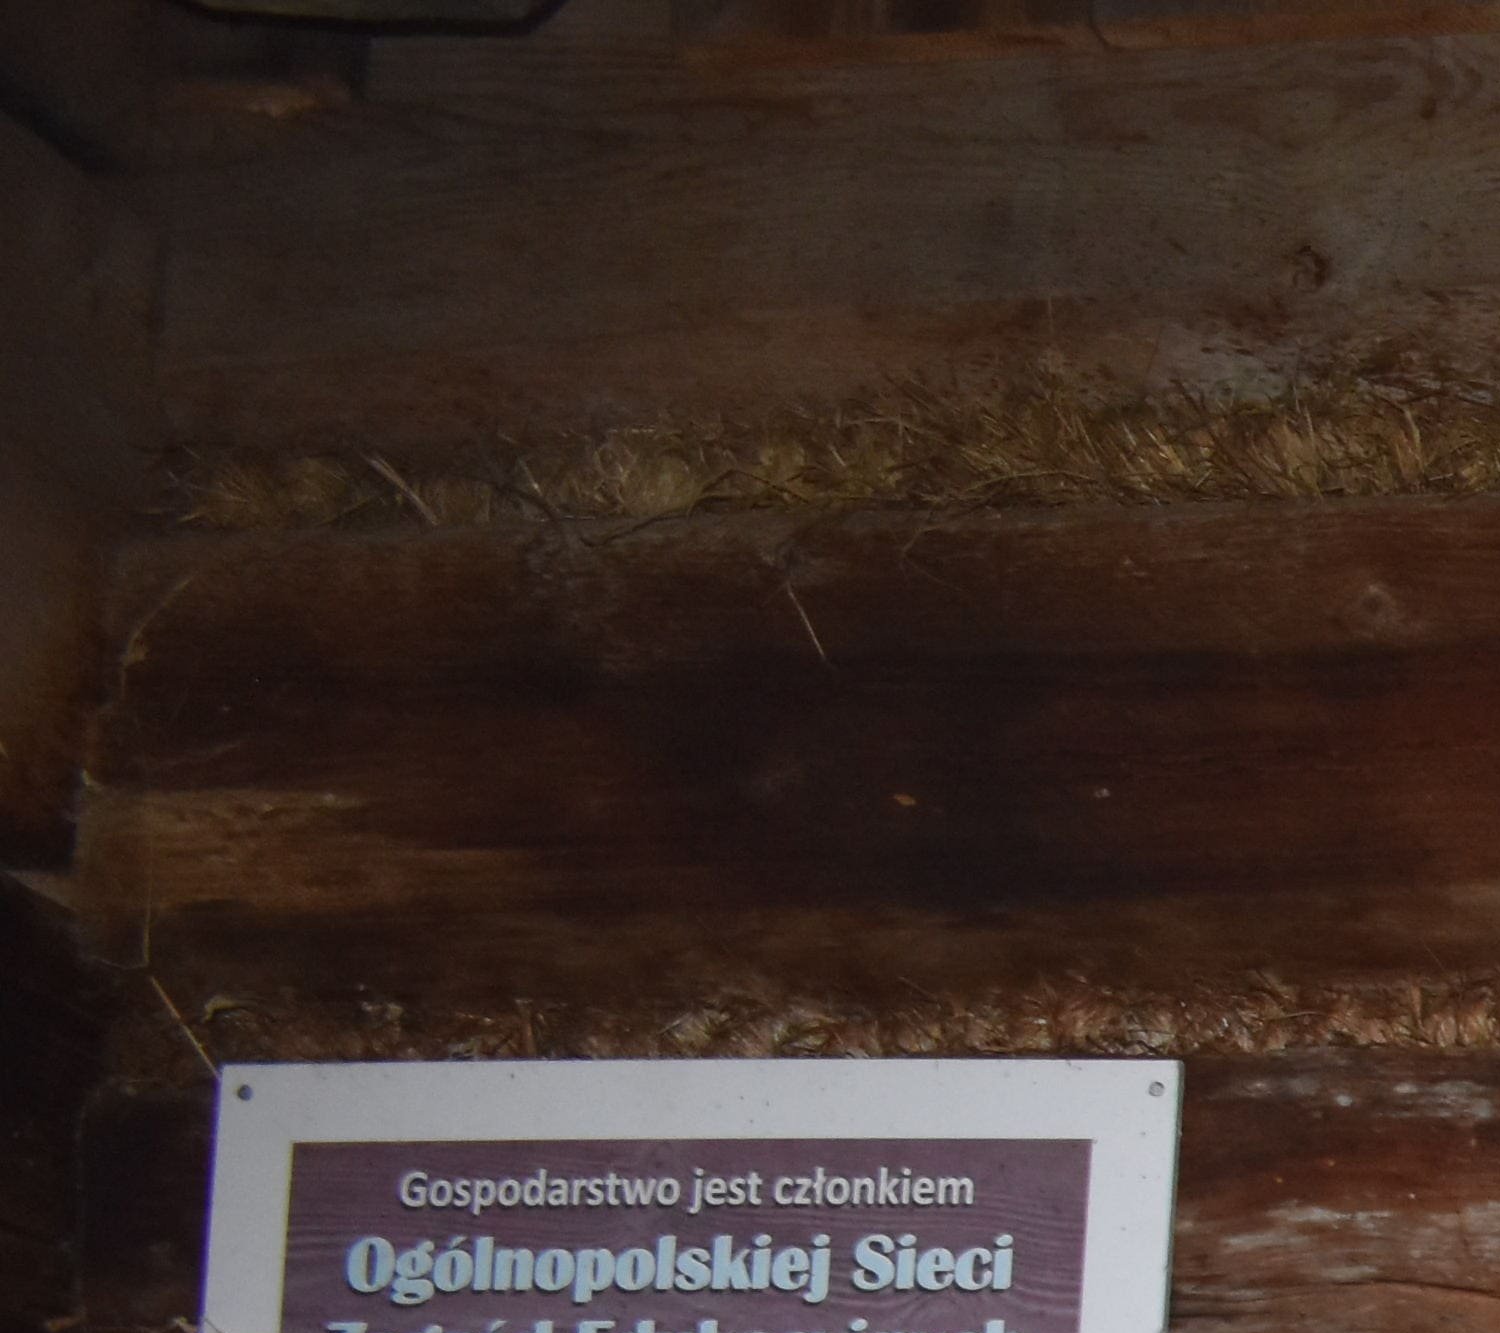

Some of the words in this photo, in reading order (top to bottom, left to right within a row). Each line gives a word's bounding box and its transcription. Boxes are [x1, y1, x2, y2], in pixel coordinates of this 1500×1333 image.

[399, 1170, 682, 1216] Gospodarstwo
[690, 1171, 764, 1215] jest
[773, 1168, 976, 1209] członkiem
[345, 1234, 833, 1305] Ogólnopolskiej
[852, 1233, 1015, 1293] Sieci
